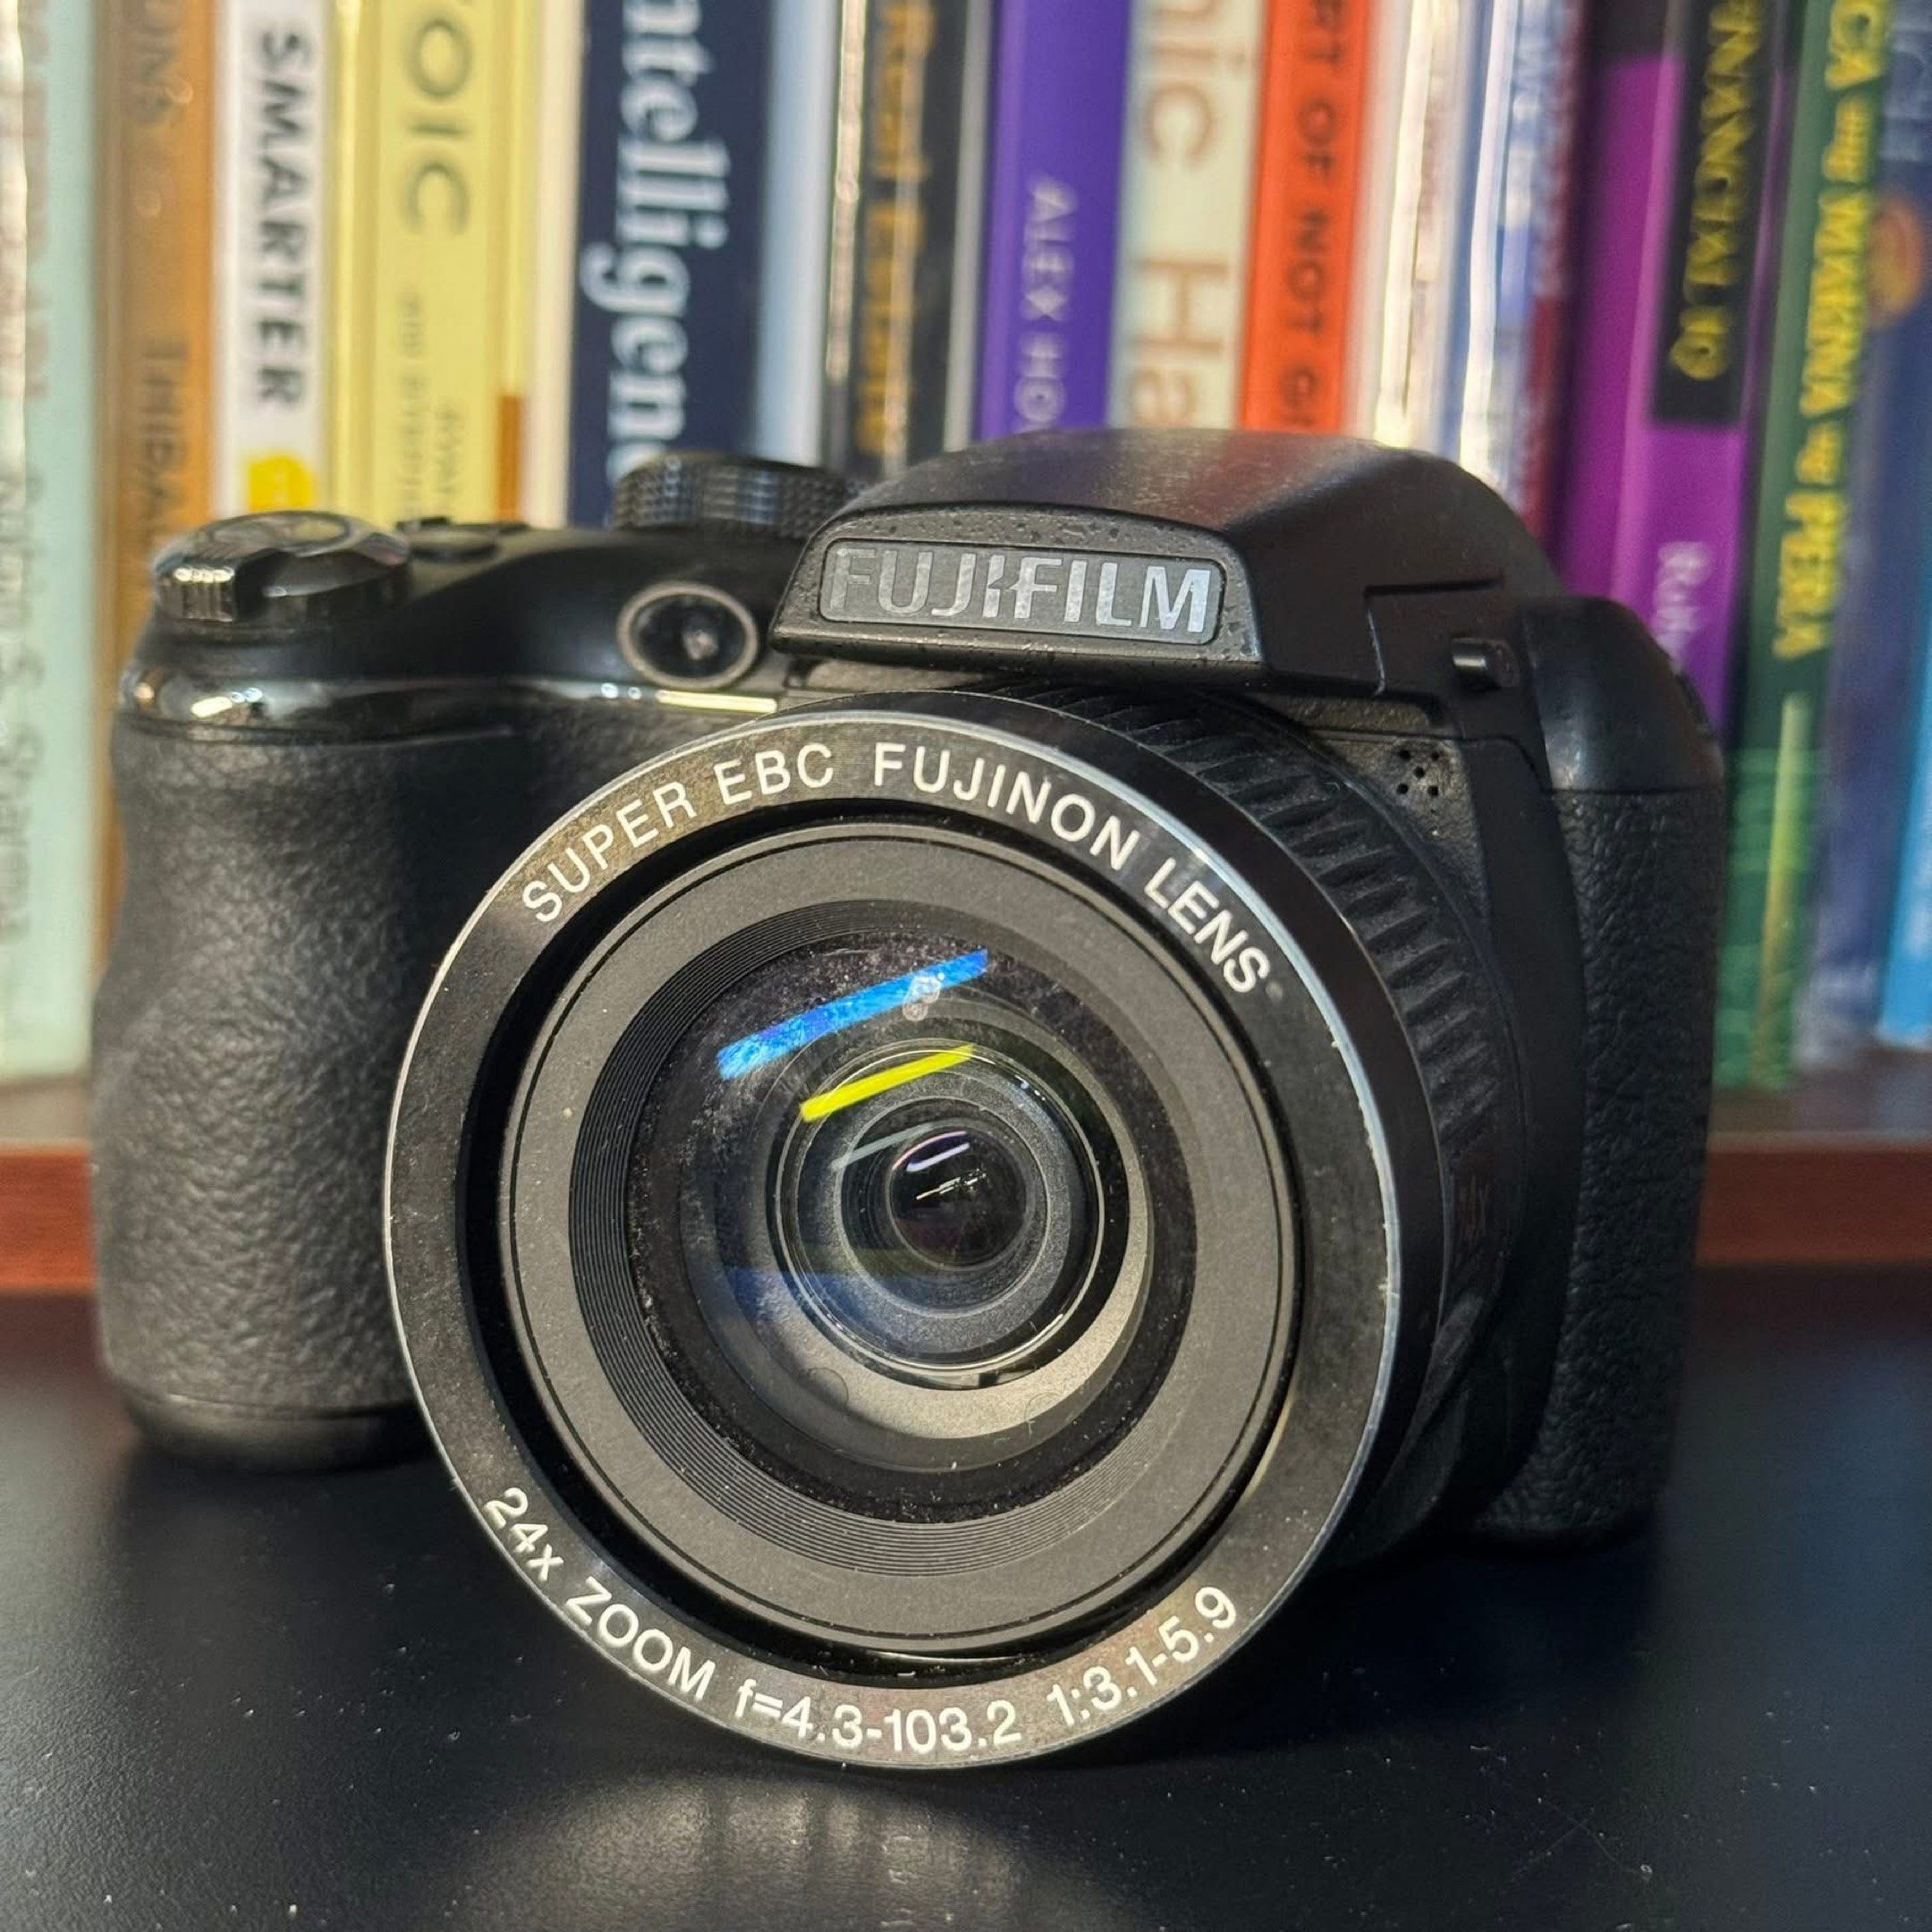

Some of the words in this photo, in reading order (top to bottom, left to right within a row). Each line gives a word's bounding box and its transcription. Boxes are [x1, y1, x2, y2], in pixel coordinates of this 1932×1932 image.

[404, 0, 474, 236] OIC
[1295, 95, 1339, 179] OF
[256, 28, 313, 411] SMARTER
[1020, 174, 1078, 324] ALEX
[1283, 206, 1332, 338] NOT
[1013, 331, 1072, 433] HO
[828, 547, 1212, 633] FUJIFILM
[521, 781, 698, 923] SUPER
[713, 741, 835, 806] EBC
[873, 741, 1140, 871] FUJINON
[1143, 857, 1271, 994] LENS
[483, 1486, 565, 1582] 24x
[564, 1575, 716, 1702] ZOOM
[733, 1677, 1024, 1754] f=4.3-103.2
[1045, 1585, 1239, 1727] 1:3.1-5.9
